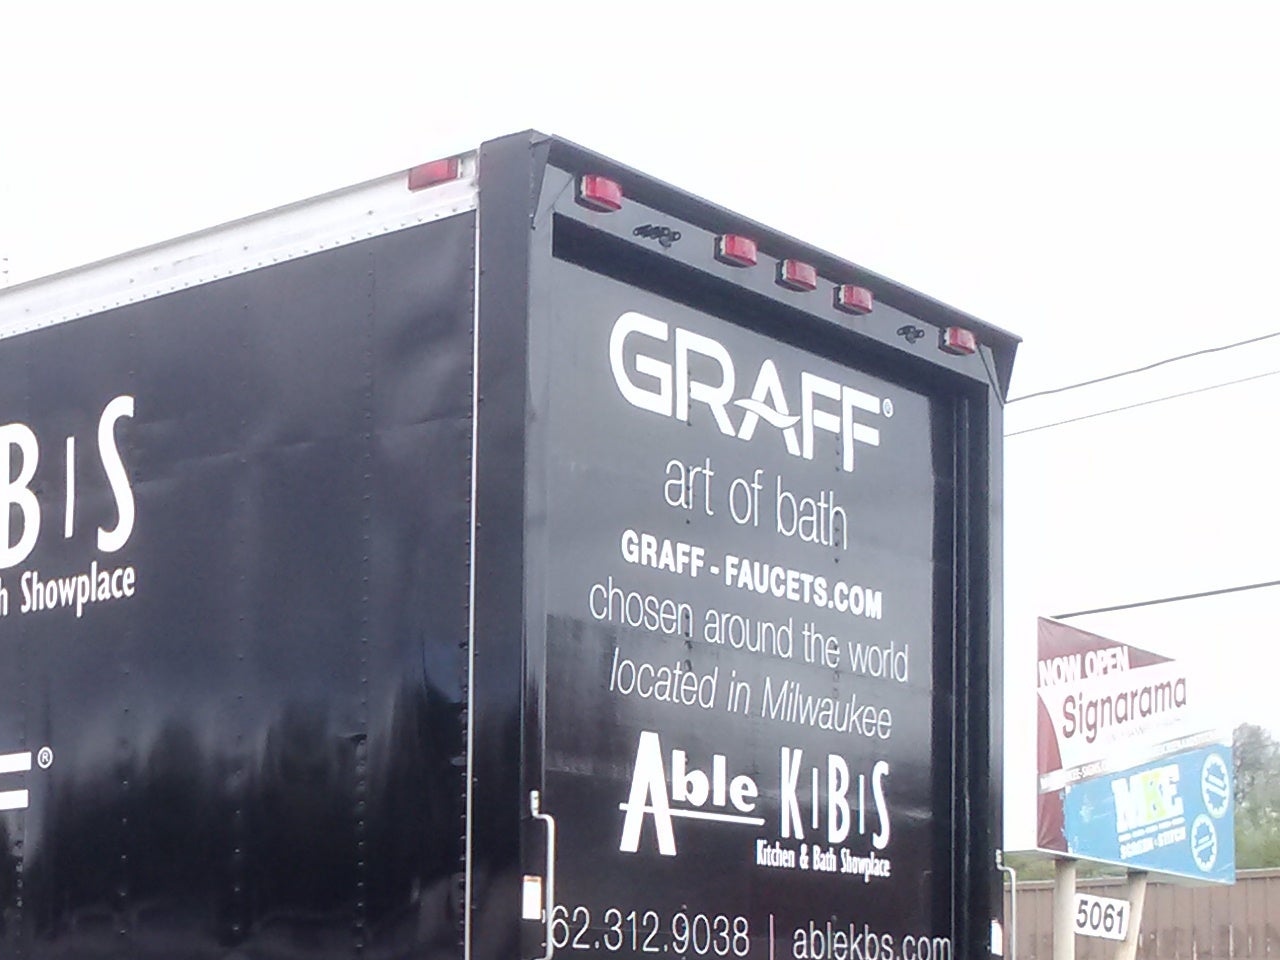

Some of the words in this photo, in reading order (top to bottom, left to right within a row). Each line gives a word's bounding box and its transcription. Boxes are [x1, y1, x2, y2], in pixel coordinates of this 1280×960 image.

[664, 457, 713, 516] art
[729, 470, 762, 526] of
[777, 475, 847, 549] bath
[20, 562, 135, 617] Showplace
[590, 576, 692, 637] chosen
[704, 608, 792, 658] around
[803, 623, 839, 668] the
[849, 642, 908, 682] world
[609, 647, 718, 709] located
[728, 671, 749, 714] in
[762, 677, 891, 739] Milwaukee
[1038, 654, 1081, 687] NOW
[1085, 646, 1130, 679] OPEN
[1063, 678, 1186, 744] Signarama
[619, 730, 765, 855] Able
[1111, 763, 1184, 833] MKE
[756, 839, 795, 868] Kitchen
[799, 844, 808, 869] &
[813, 845, 837, 871] Bath
[841, 848, 891, 883] Showplace
[541, 905, 750, 956] 62.312.9038
[1076, 899, 1123, 934] 5061
